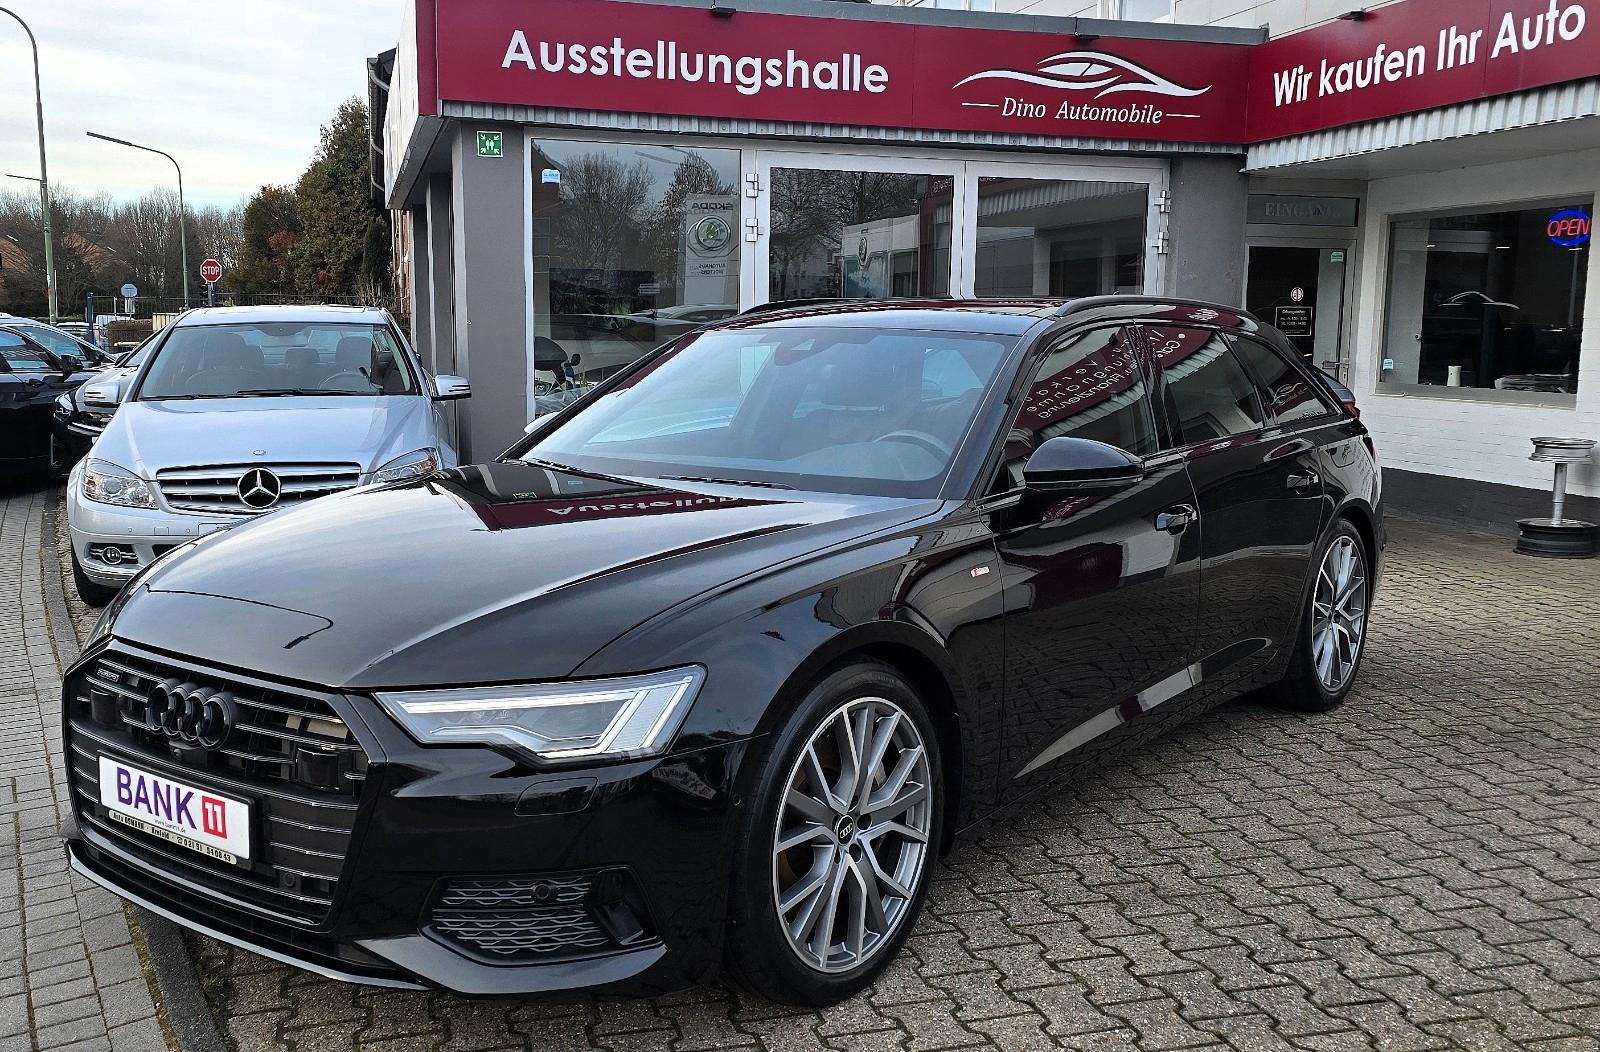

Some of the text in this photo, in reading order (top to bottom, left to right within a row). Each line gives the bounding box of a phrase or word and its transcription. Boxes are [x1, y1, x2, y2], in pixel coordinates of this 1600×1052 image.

[501, 29, 889, 96] Ausstellungshalle
[1273, 0, 1586, 107] Wir kaufen Ihr Auto
[1001, 97, 1163, 124] Dino Automobile
[1547, 218, 1590, 237] OPEN
[202, 266, 220, 276] STOP
[116, 766, 225, 836] BANK 11
